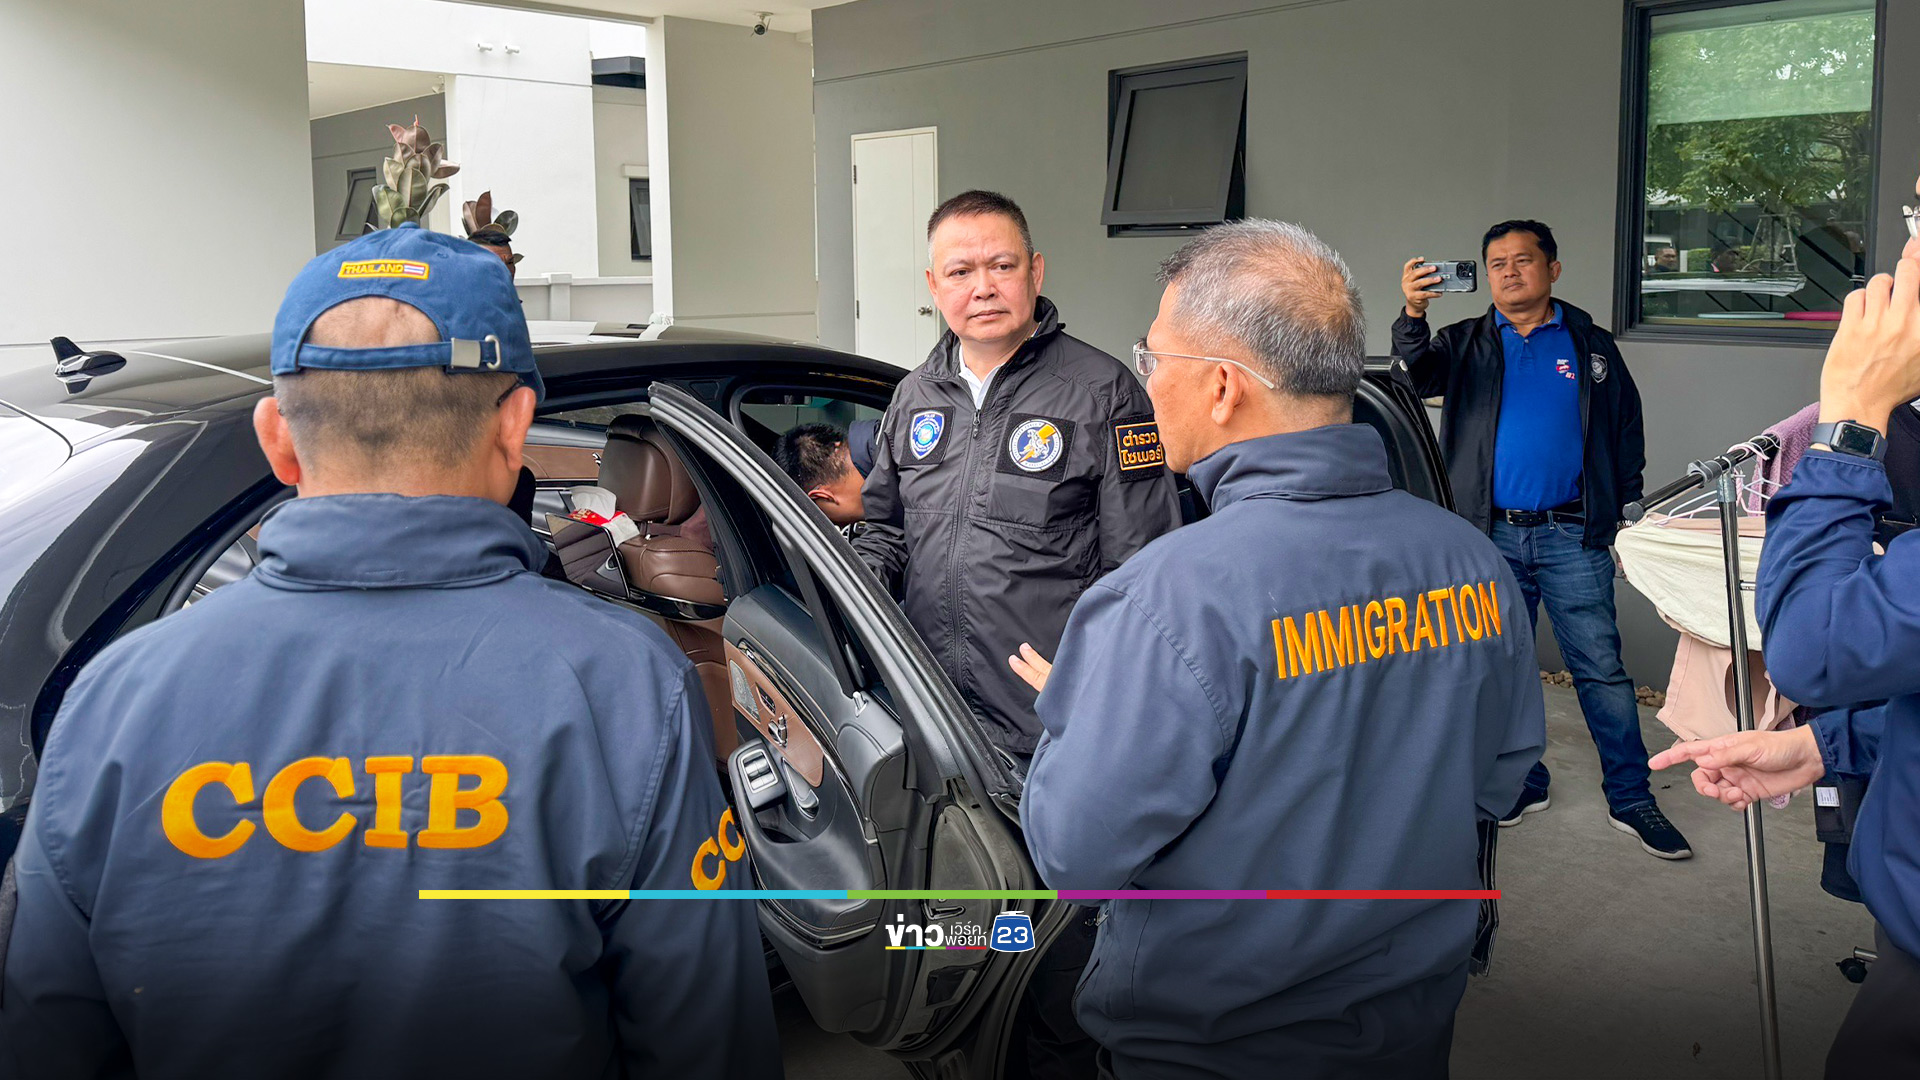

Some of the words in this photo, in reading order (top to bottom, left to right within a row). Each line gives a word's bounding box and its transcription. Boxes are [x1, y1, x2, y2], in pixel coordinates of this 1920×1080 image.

[345, 263, 404, 274] THAILAND
[1122, 429, 1158, 447] ตำรวจ
[1120, 444, 1163, 465] ไซเบอร์
[1271, 581, 1501, 680] IMMIGRATION
[161, 754, 509, 859] CCIB
